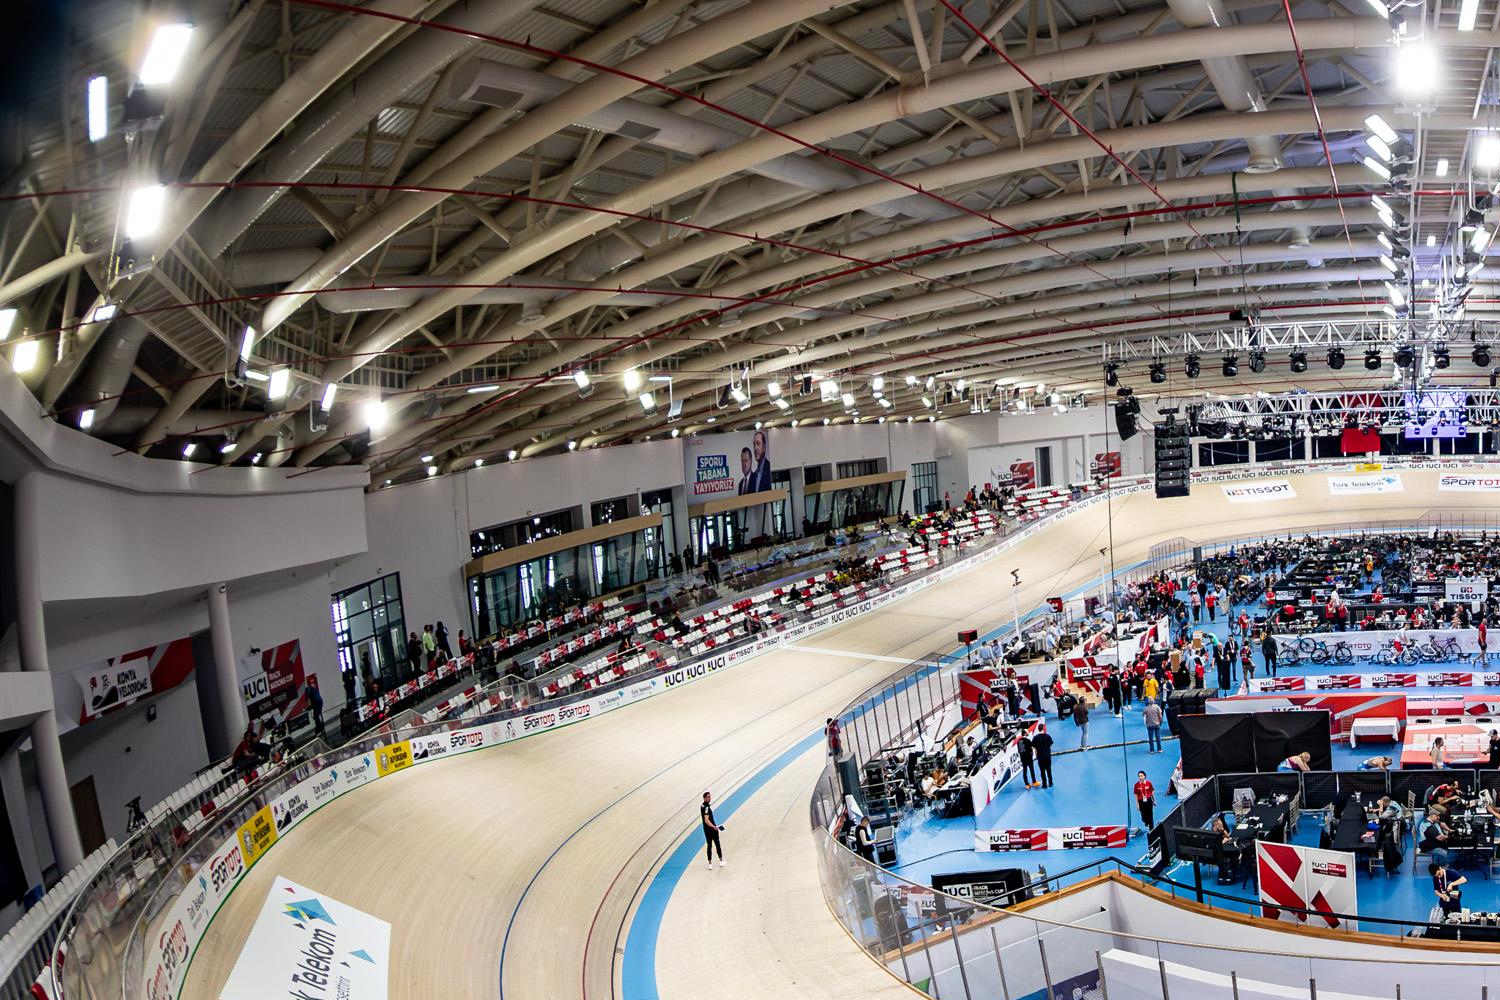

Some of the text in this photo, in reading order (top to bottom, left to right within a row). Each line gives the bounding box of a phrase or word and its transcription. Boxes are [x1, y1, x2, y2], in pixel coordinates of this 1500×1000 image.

[700, 457, 723, 468] SPORU
[698, 469, 727, 481] TABANA
[694, 480, 733, 494] YAYIYORUZ
[1244, 484, 1289, 496] TISSOT
[848, 608, 858, 618] UCI
[862, 602, 872, 612] UCI
[813, 618, 829, 628] TISSOT
[834, 612, 845, 623] UCI
[790, 627, 806, 637] TISSOT
[764, 637, 780, 648] TISSOT
[736, 646, 754, 659] TISSOT
[711, 656, 726, 670] UCI
[690, 664, 706, 678] UCI
[1077, 668, 1091, 676] UCI
[117, 669, 137, 686] KONYA
[668, 672, 684, 686] UCI
[993, 679, 1007, 687] UCI
[119, 678, 148, 699] VELODROME
[248, 677, 268, 698] UCI
[558, 704, 590, 720] SPORTOTO
[523, 713, 556, 730] SPORTOTO
[450, 731, 483, 748] SPORTOTO
[994, 834, 1008, 843] UCI
[1066, 832, 1083, 840] UCI
[211, 846, 242, 893] SPORTOTO
[950, 886, 971, 897] UCI
[162, 919, 186, 980] SPORTOTO
[292, 928, 337, 992] Telekom
